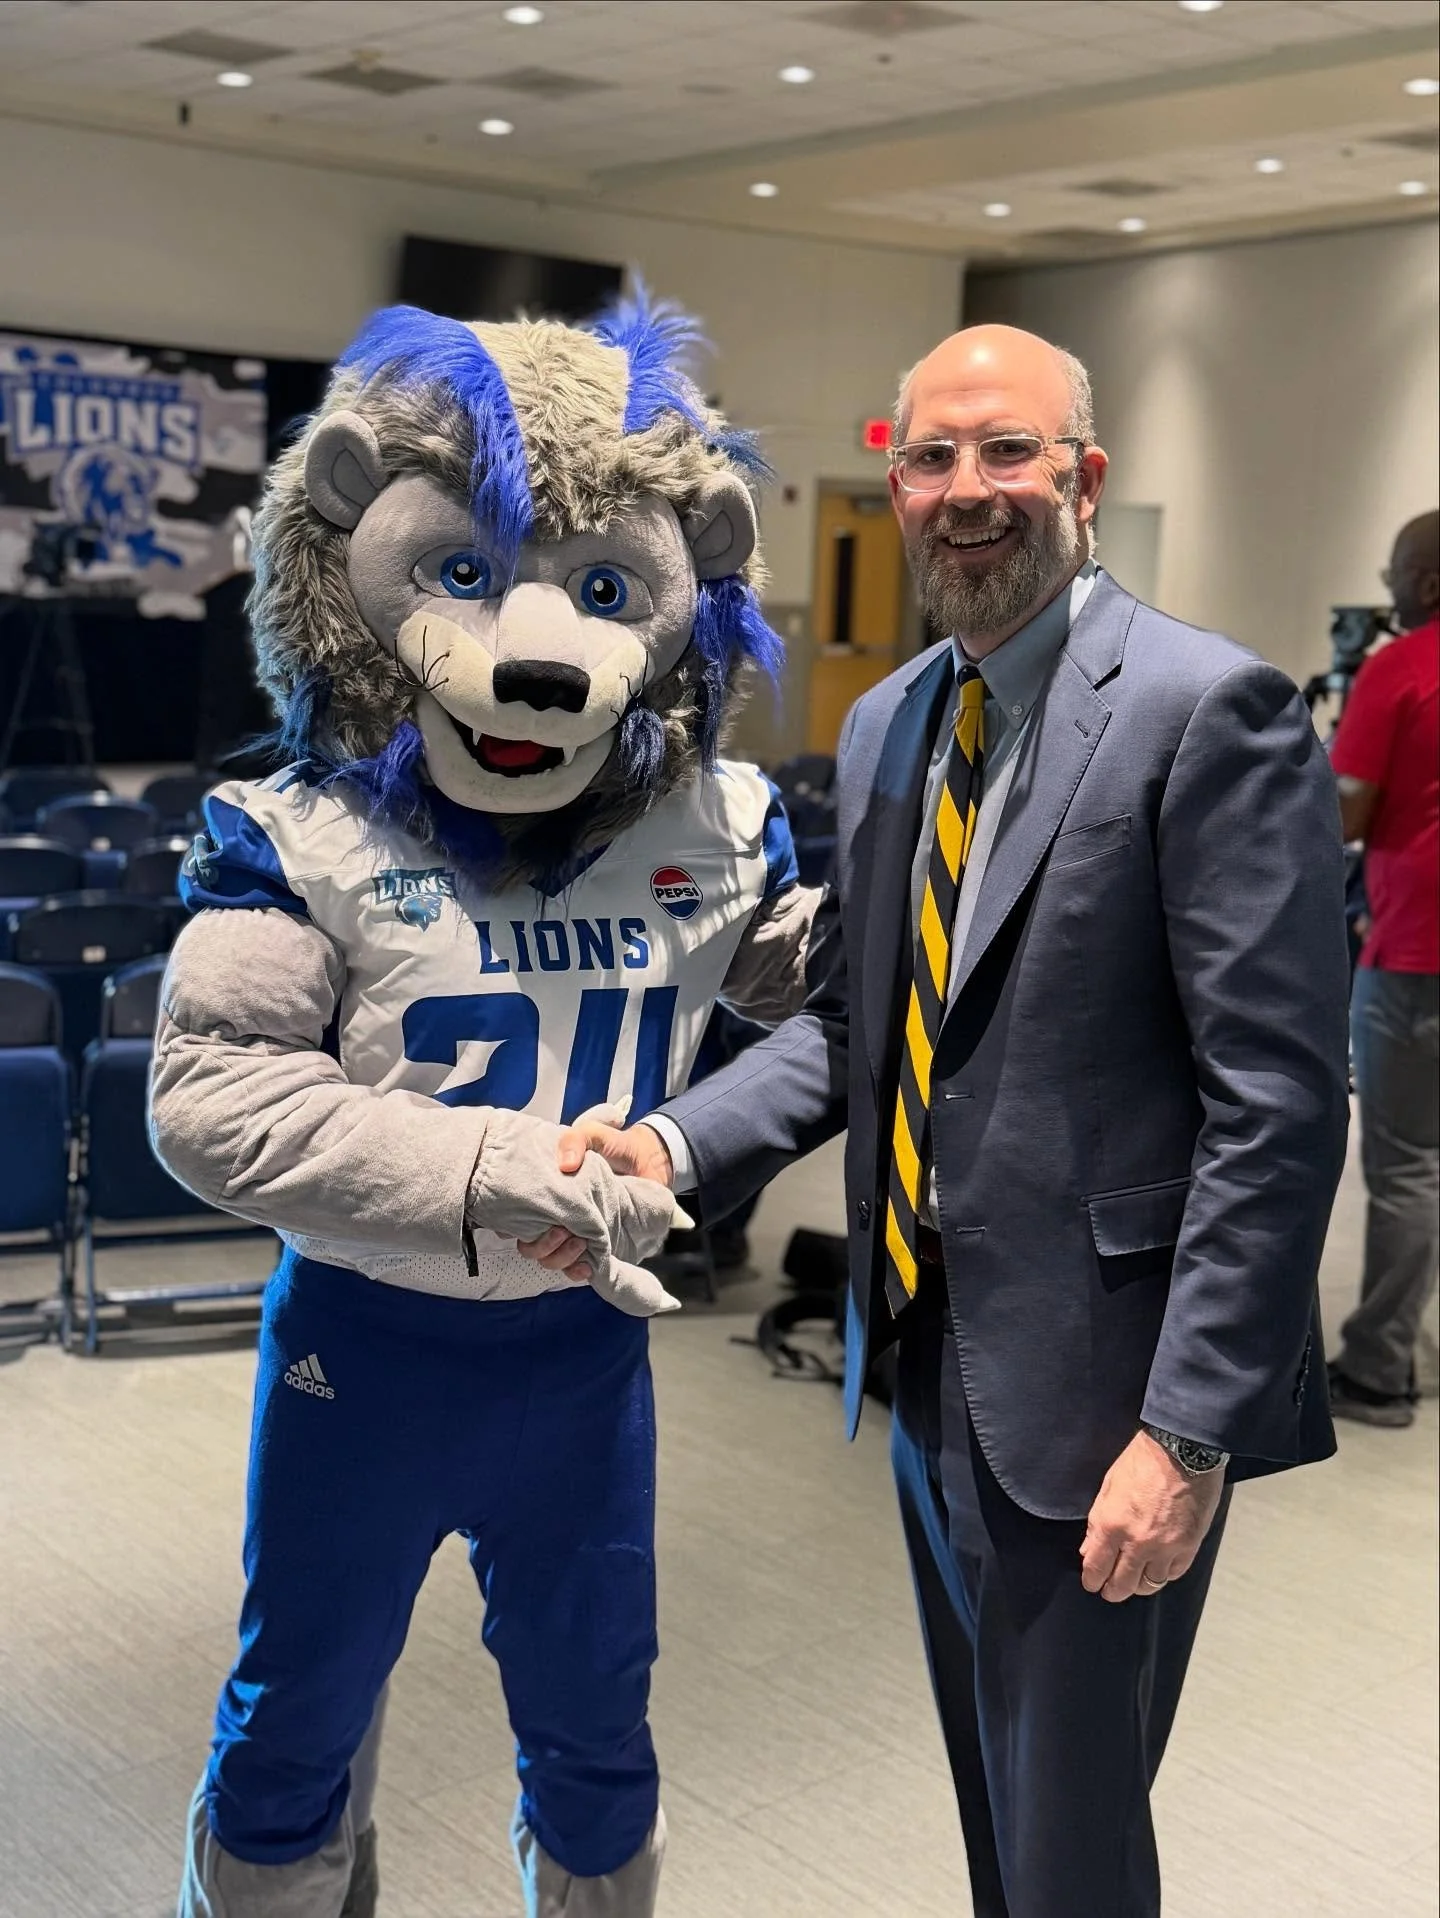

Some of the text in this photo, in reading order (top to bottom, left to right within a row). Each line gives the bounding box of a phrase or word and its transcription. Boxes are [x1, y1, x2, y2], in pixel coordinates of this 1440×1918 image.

[15, 390, 196, 462] LIONS
[378, 874, 454, 901] LIONS
[654, 887, 700, 899] PEPSI
[474, 917, 650, 975] LIONS
[284, 1372, 335, 1400] adidas
